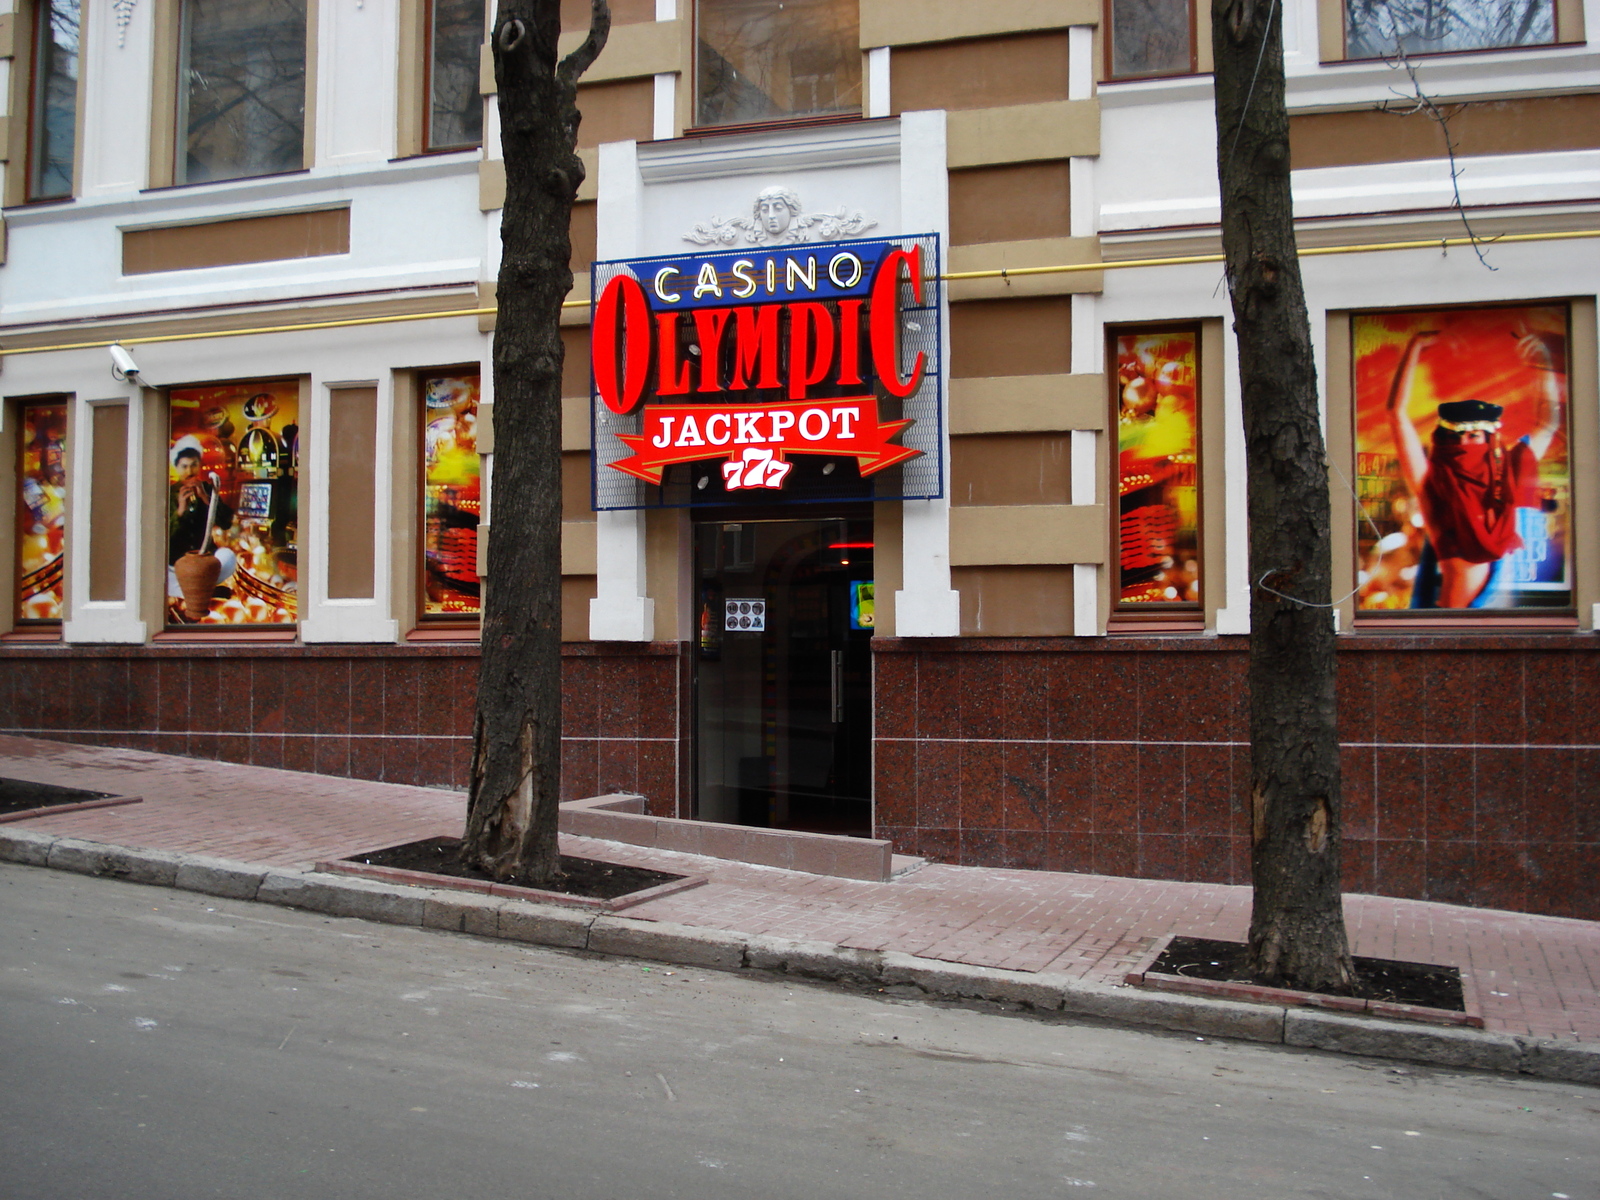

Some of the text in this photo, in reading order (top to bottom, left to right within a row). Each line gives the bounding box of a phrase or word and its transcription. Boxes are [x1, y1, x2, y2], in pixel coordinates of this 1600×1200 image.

[653, 251, 862, 303] CASINO
[592, 244, 924, 415] OLYMPIC
[652, 407, 860, 449] JACKPOT
[723, 447, 793, 490] 777
